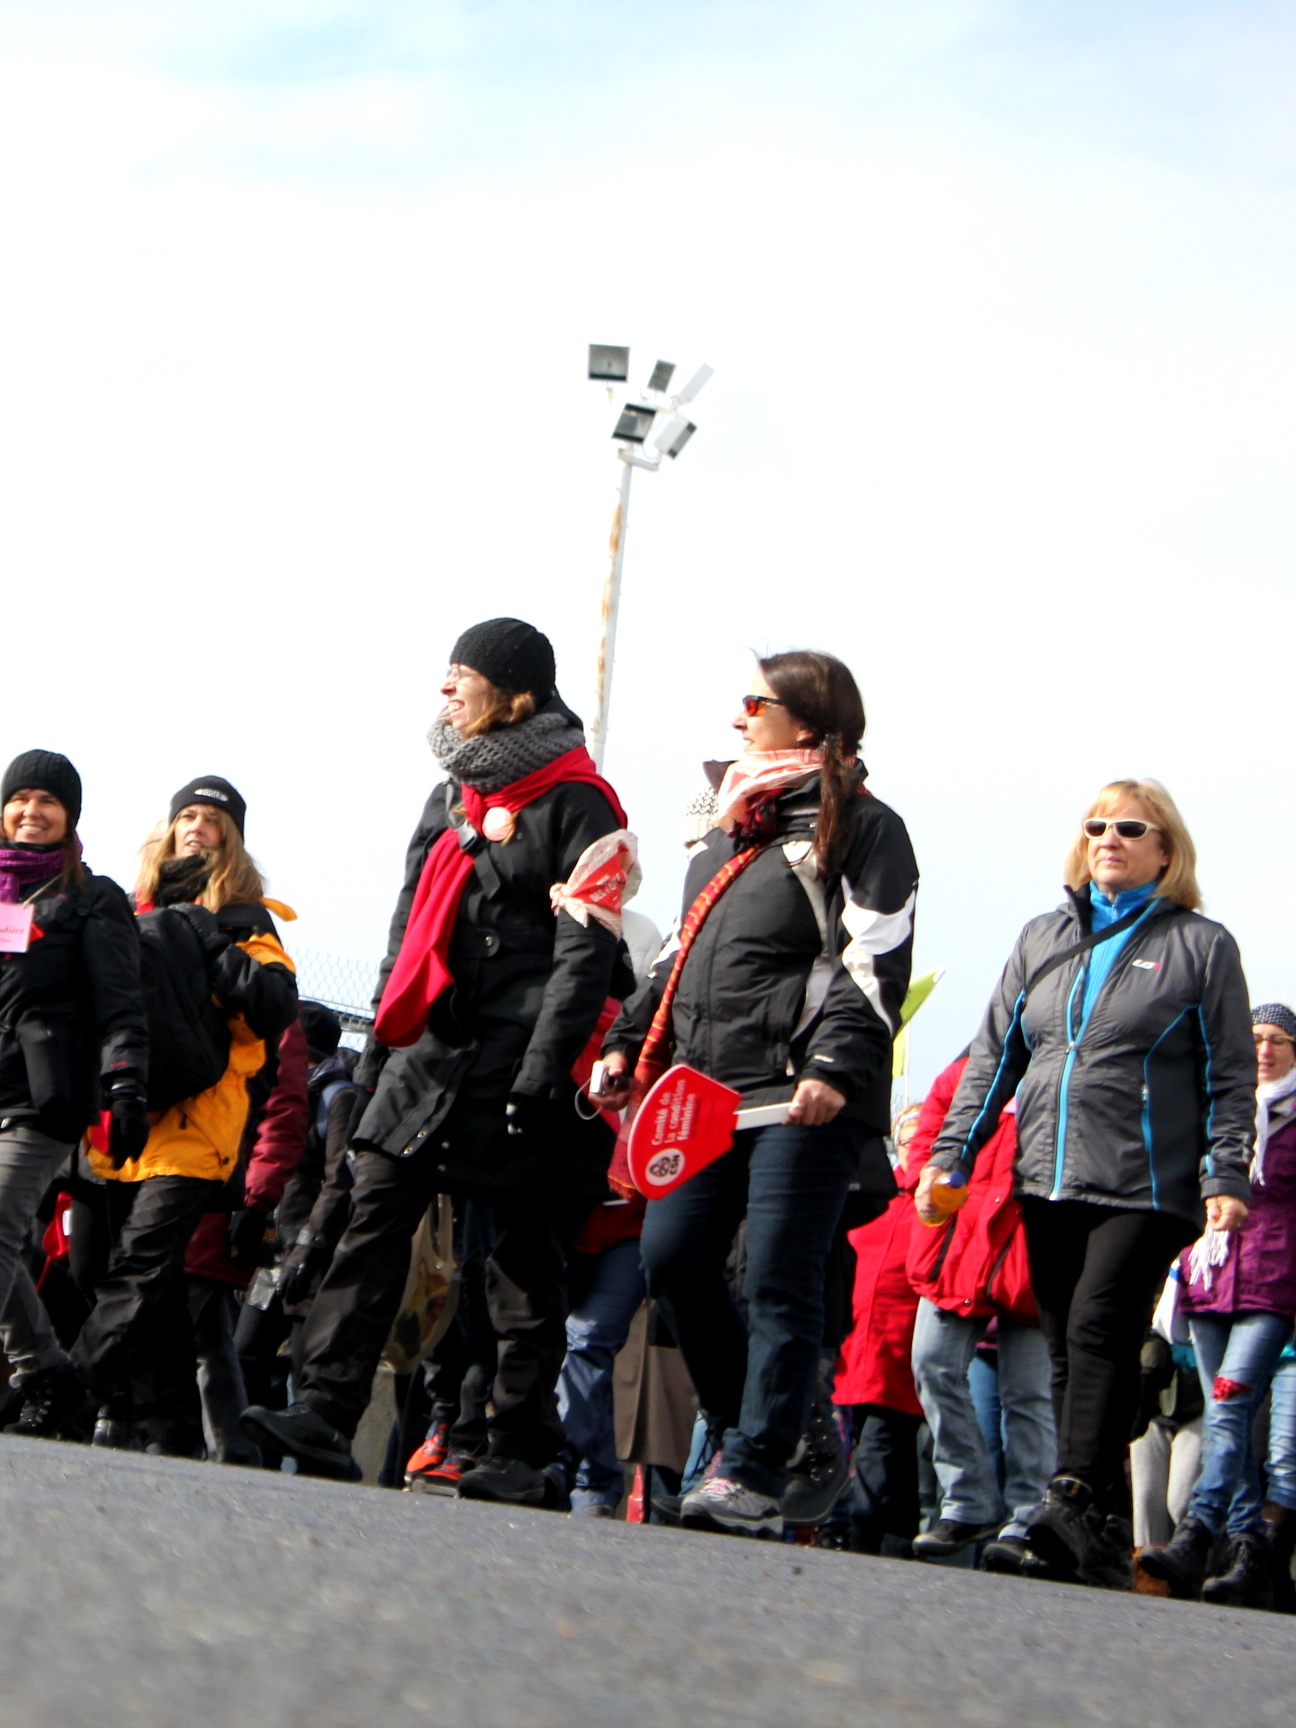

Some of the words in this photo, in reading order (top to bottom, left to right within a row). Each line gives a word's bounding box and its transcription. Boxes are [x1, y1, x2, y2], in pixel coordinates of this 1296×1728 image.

[658, 1092, 671, 1106] de
[669, 1079, 686, 1130] condition
[677, 1093, 696, 1141] féminine
[651, 1108, 669, 1146] Comité
